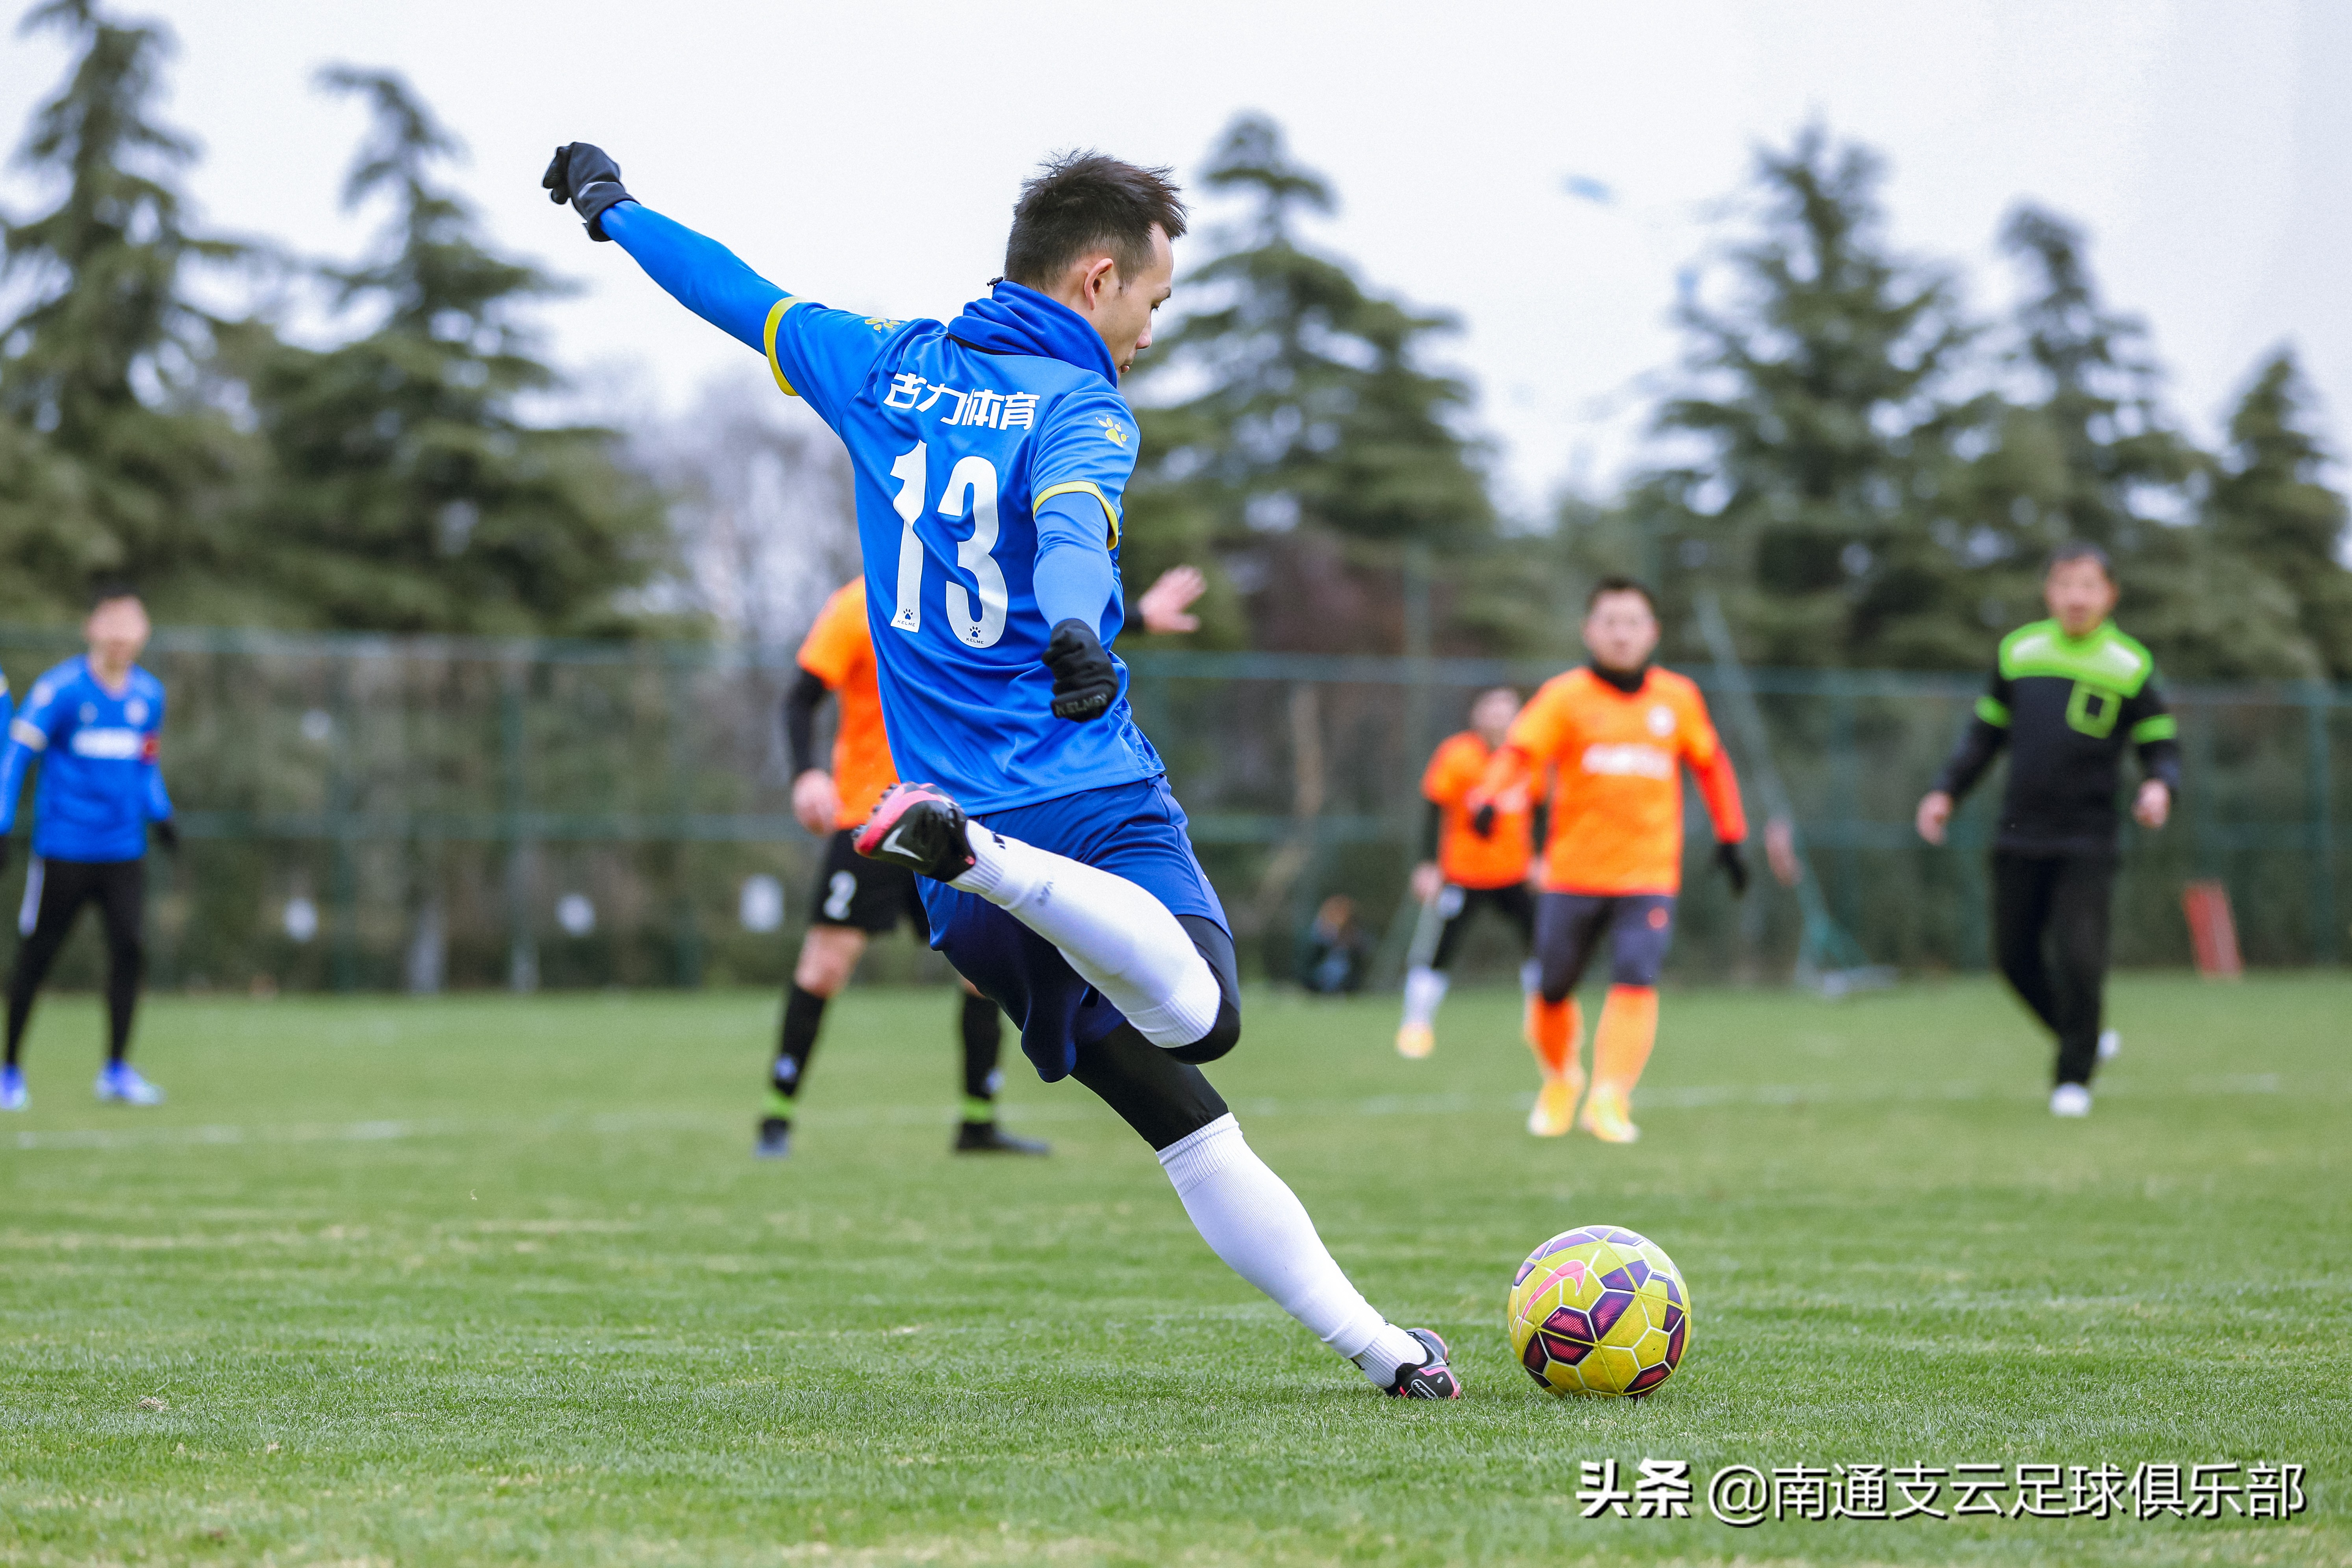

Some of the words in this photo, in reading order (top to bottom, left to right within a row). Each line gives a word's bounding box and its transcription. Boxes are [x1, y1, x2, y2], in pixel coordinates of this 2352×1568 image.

[883, 373, 1040, 430] 古力体育
[890, 439, 1008, 648] 13
